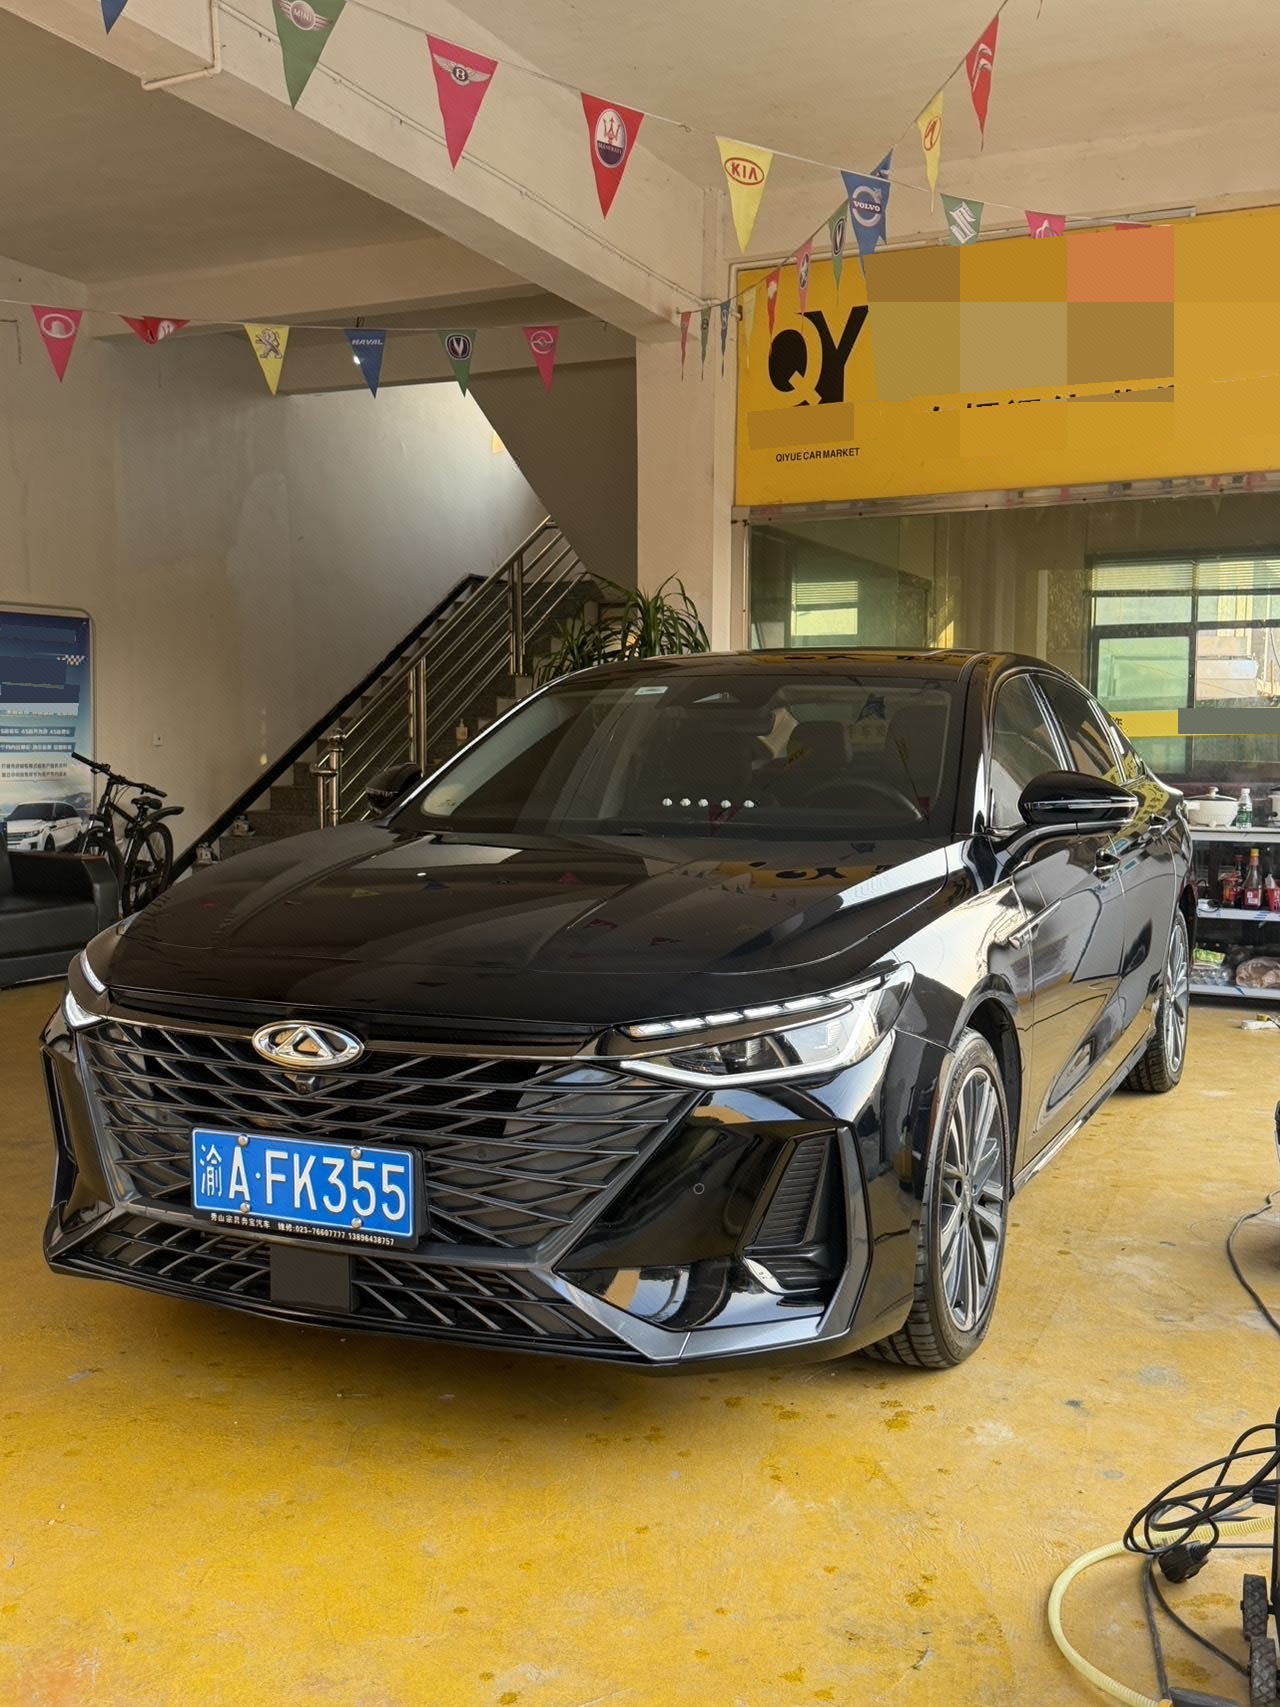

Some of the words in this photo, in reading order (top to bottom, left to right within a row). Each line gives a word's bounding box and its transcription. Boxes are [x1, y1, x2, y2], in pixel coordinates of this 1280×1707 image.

[292, 8, 313, 22] MINI
[731, 162, 758, 181] KIA
[853, 200, 881, 212] VOLVO
[351, 338, 384, 346] HAVAL
[768, 305, 869, 407] QY
[775, 452, 802, 462] QIYUE
[803, 450, 821, 460] CAR
[822, 447, 860, 459] MARKET
